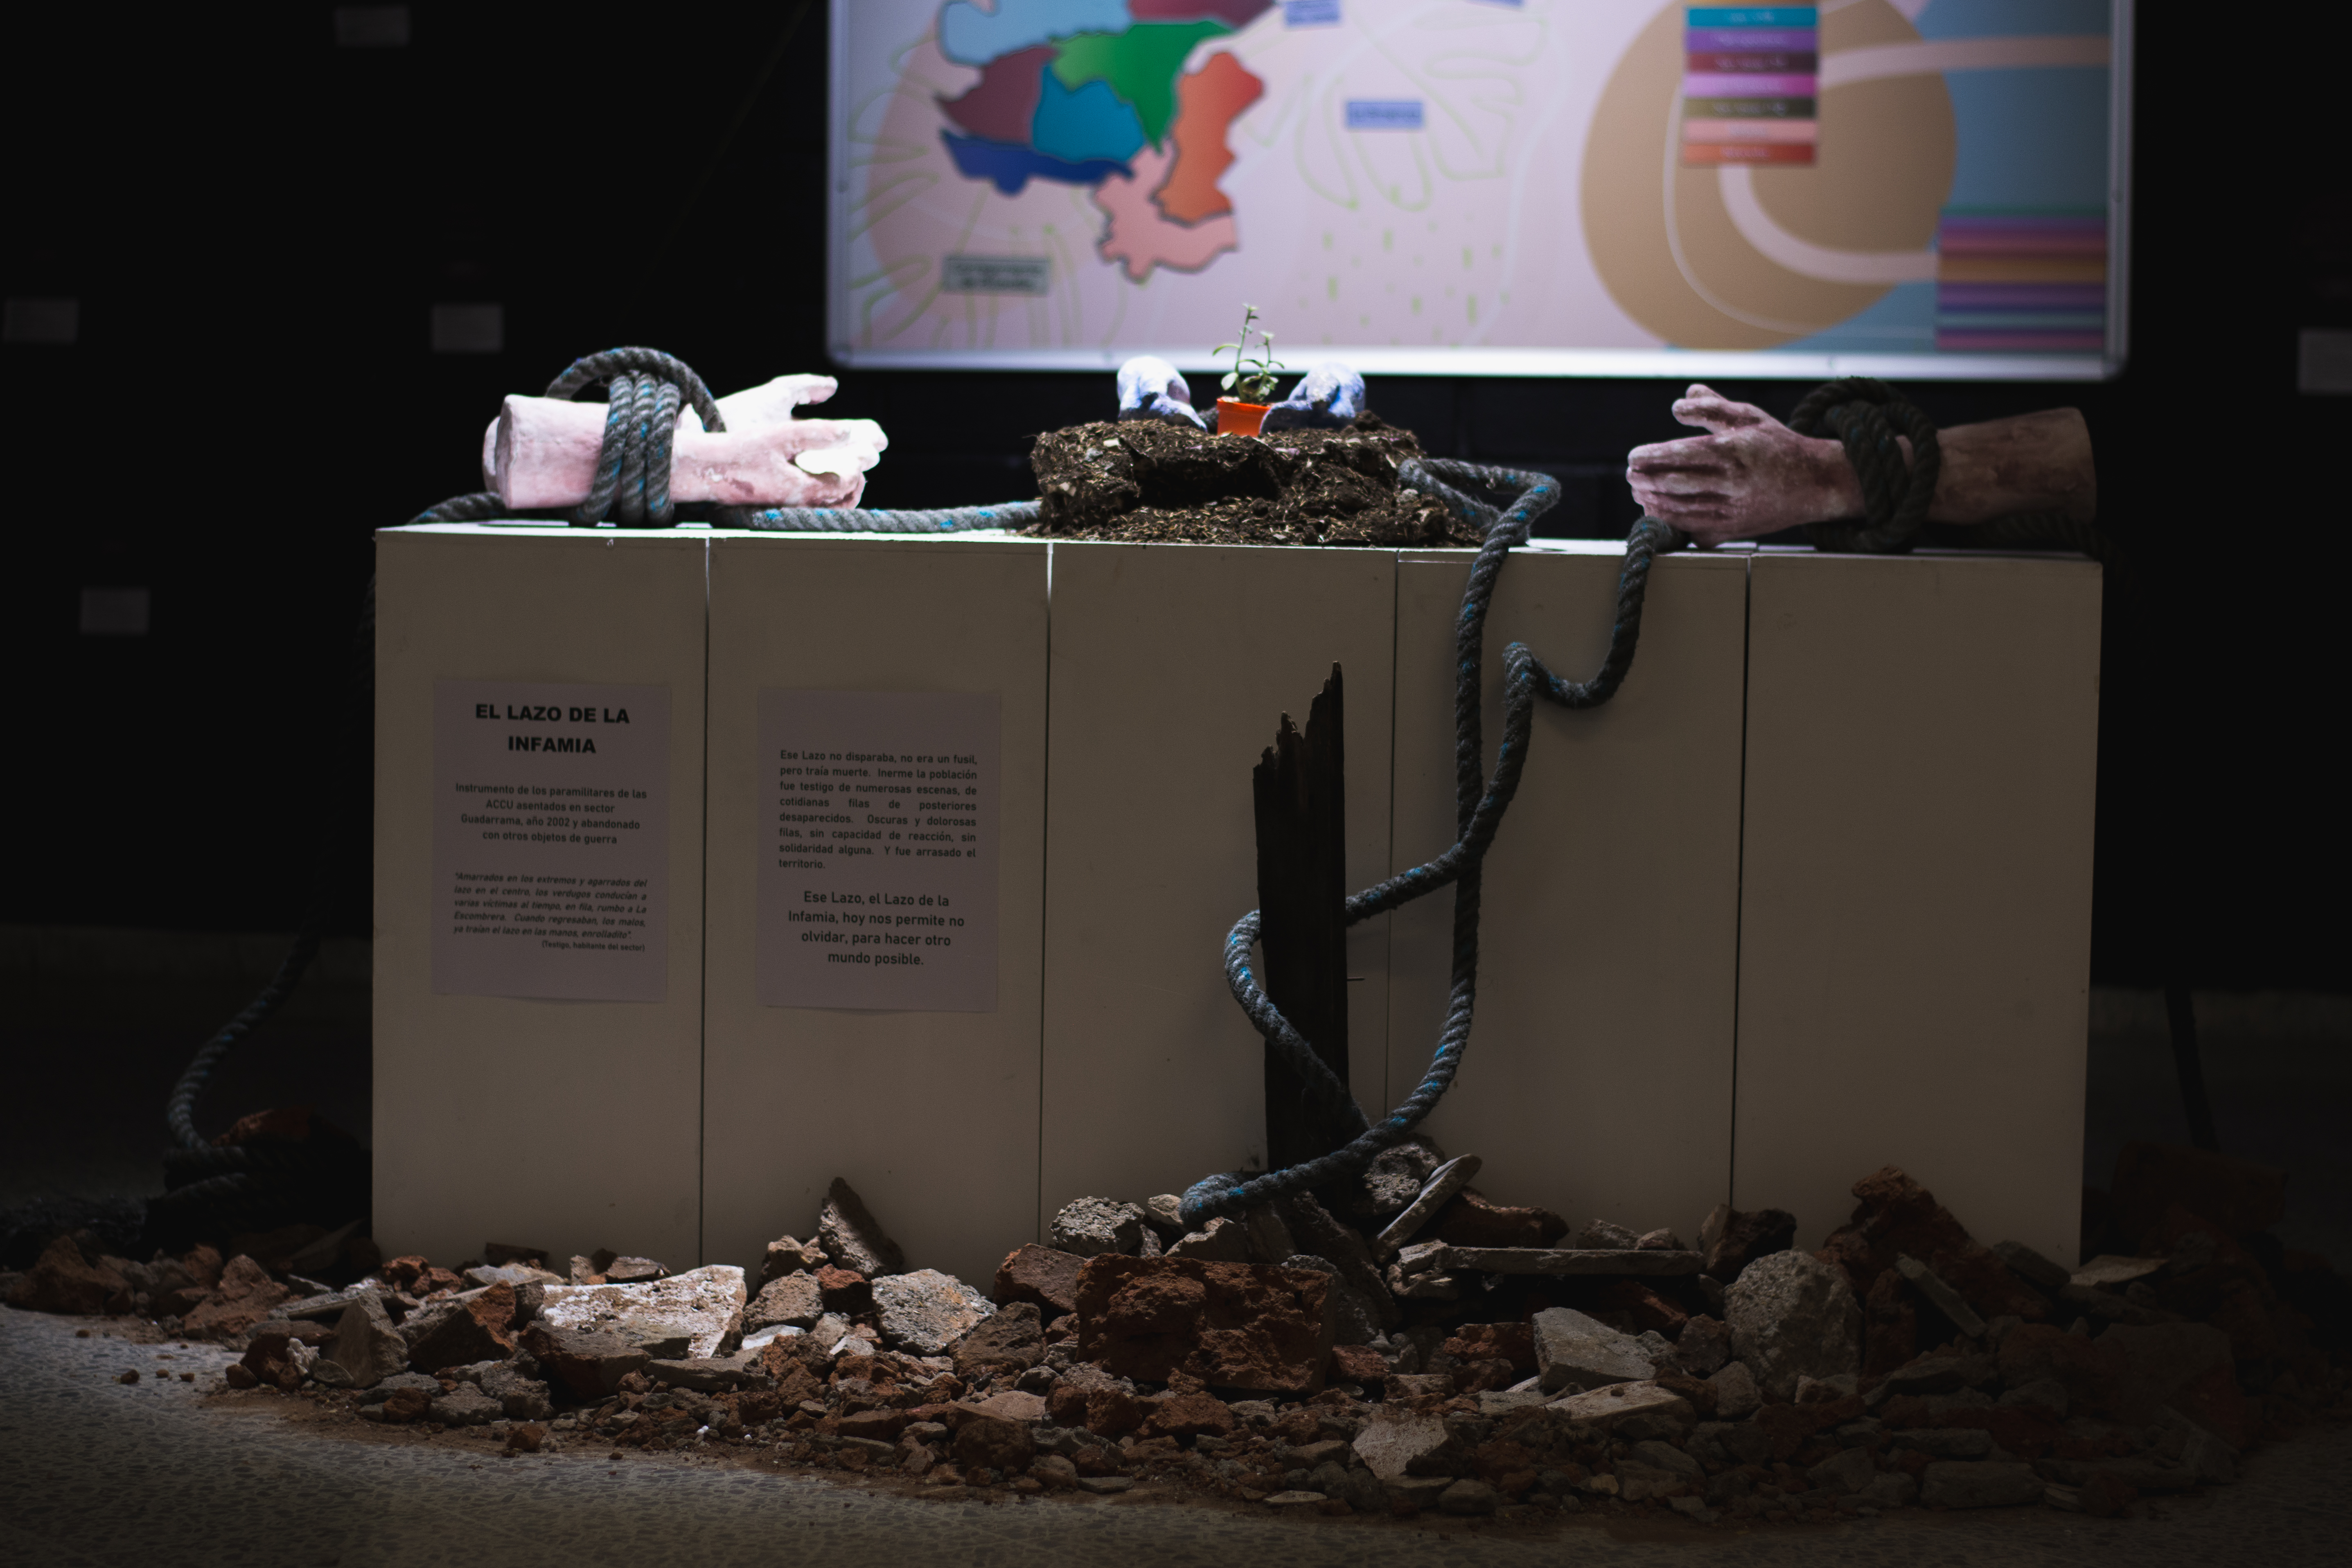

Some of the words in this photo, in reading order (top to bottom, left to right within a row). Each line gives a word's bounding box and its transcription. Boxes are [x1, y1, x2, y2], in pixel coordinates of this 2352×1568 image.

[475, 703, 501, 720] EL
[507, 704, 562, 722] LAZO
[569, 707, 596, 723] DE
[603, 708, 630, 724] LA
[508, 735, 596, 754] INFAMIA
[780, 749, 798, 760] Ese
[802, 750, 826, 761] Lazo
[829, 753, 842, 761] no
[845, 751, 897, 764] disparaba,
[900, 755, 913, 763] no
[916, 755, 934, 764] era
[937, 756, 950, 764] un
[953, 754, 978, 766] fusil,
[780, 767, 803, 777] pero
[805, 765, 829, 776] traía
[832, 768, 871, 777] muerte.
[877, 768, 913, 778] Inerme
[916, 769, 926, 779] la
[929, 769, 977, 781] población
[455, 782, 515, 794] Instrumento
[517, 785, 530, 795] de
[532, 785, 547, 796] los
[549, 787, 615, 798] paramilitares
[617, 788, 629, 799] de
[632, 789, 647, 799] las
[779, 780, 796, 791] fue
[799, 782, 834, 794] testigo
[838, 783, 851, 792] de
[855, 785, 912, 794] numerosas
[916, 786, 960, 796] escenas,
[965, 785, 977, 796] de
[485, 799, 514, 810] ACCU
[516, 801, 567, 812] asentados
[568, 804, 582, 812] en
[584, 804, 615, 813] sector
[779, 796, 830, 807] cotidianas
[848, 798, 870, 808] filas
[888, 799, 901, 809] de
[919, 801, 977, 812] posteriores
[460, 813, 523, 826] Guadarrama,
[525, 815, 544, 826] año
[546, 816, 570, 828] 2002
[572, 820, 578, 830] y
[580, 818, 640, 830] abandonado
[779, 811, 853, 824] desaparecidos.
[867, 814, 908, 825] Oscuras
[914, 818, 921, 828] y
[926, 816, 976, 827] dolorosas
[482, 831, 500, 840] con
[502, 831, 528, 842] otros
[530, 832, 567, 844] objetos
[569, 833, 581, 843] de
[584, 835, 617, 845] guerra
[779, 827, 803, 839] filas,
[810, 828, 824, 838] sin
[831, 830, 882, 841] capacidad
[888, 830, 901, 840] de
[908, 830, 954, 843] reacción,
[961, 833, 976, 842] sin
[779, 843, 833, 854] solidaridad
[838, 845, 874, 857] alguna.
[884, 845, 891, 855] Y
[895, 846, 911, 856] fue
[916, 847, 962, 857] arrasado
[966, 848, 976, 858] el
[778, 859, 825, 869] territorio.
[588, 879, 630, 887] agarrados
[553, 890, 591, 899] verdugos
[595, 891, 637, 900] conducían
[803, 890, 828, 903] Ese
[831, 891, 865, 905] Lazo,
[868, 892, 881, 905] el
[884, 893, 915, 906] Lazo
[918, 893, 934, 907] de
[937, 894, 949, 907] la
[532, 902, 561, 911] tiempo,
[579, 903, 593, 911] fila,
[514, 914, 545, 922] Cuando
[549, 916, 598, 925] regresaban,
[788, 910, 839, 925] Infamia,
[842, 911, 866, 927] hoy
[869, 914, 892, 925] nos
[895, 914, 945, 927] permite
[949, 917, 965, 927] no
[542, 940, 571, 949] (Testigo,
[801, 930, 848, 945] olvidar,
[852, 934, 881, 946] para
[884, 932, 922, 945] hacer
[925, 934, 951, 947] otro
[828, 952, 871, 964] mundo
[874, 953, 924, 967] posible.
